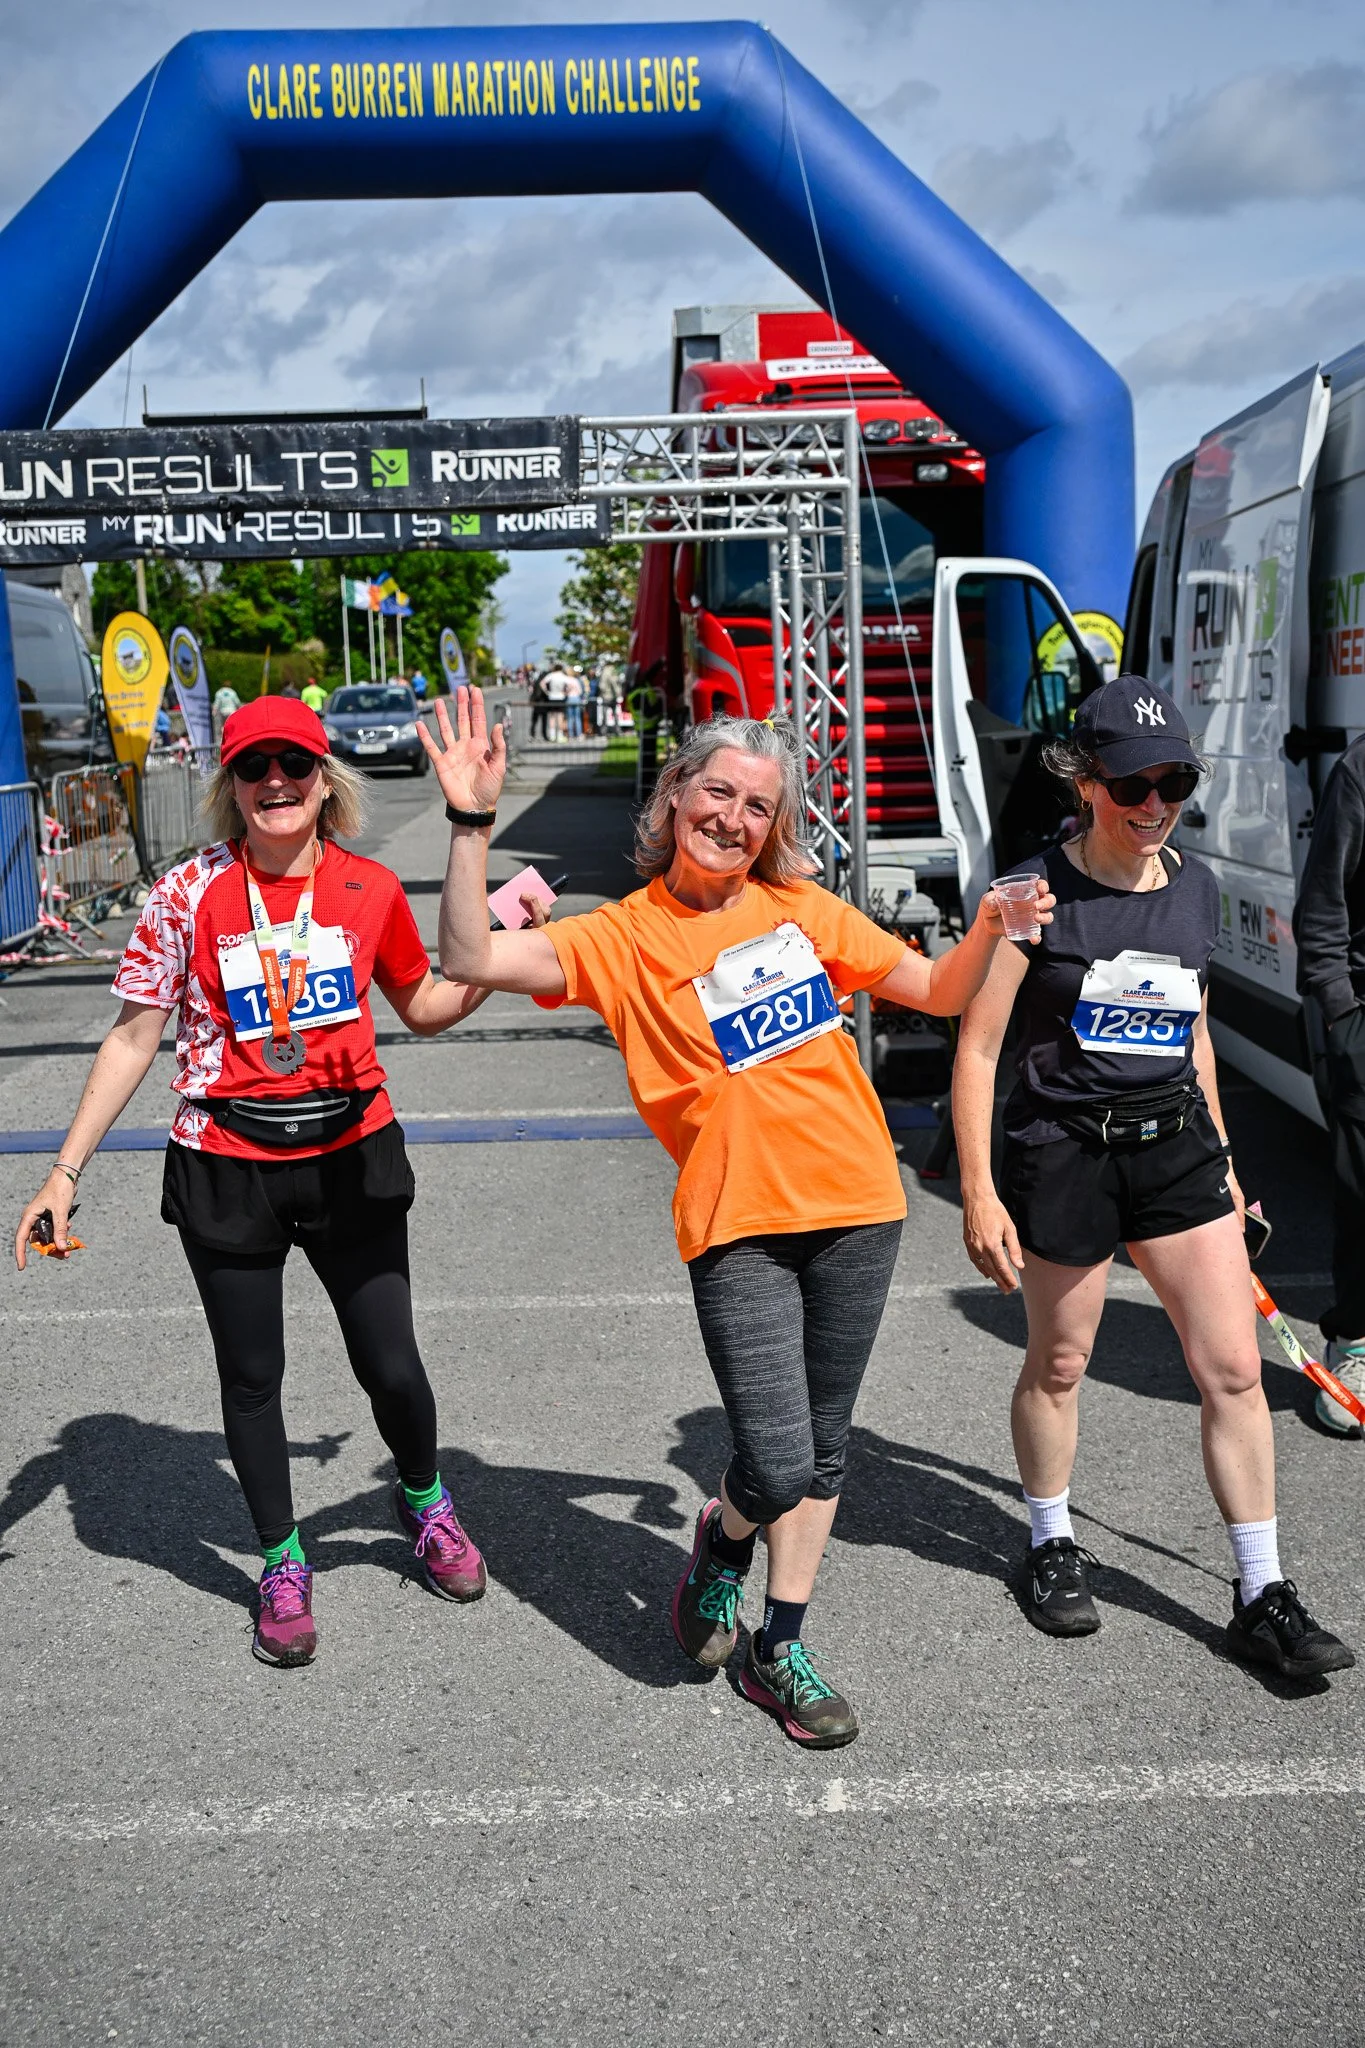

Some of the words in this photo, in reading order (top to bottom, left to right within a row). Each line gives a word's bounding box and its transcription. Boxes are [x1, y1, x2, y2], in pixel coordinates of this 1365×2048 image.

[247, 63, 323, 120] CLARE
[331, 62, 424, 119] BURREN
[432, 60, 556, 118] MARATHON
[564, 56, 701, 116] CHALLENGE
[86, 452, 358, 497] RESULTS
[431, 449, 561, 483] RUNNER
[103, 515, 131, 531] MY
[134, 514, 226, 545] RUN
[497, 510, 597, 533] RUNNER
[1193, 565, 1251, 652] RUN
[1133, 696, 1167, 726] NY
[298, 910, 310, 939] MONKS
[1239, 899, 1262, 939] RW
[760, 970, 784, 984] BURREN
[269, 984, 280, 1010] CLARE
[1141, 990, 1166, 998] BURREN
[731, 983, 813, 1051] 1287
[1089, 1007, 1180, 1041] 1285
[1140, 1132, 1158, 1141] RUN
